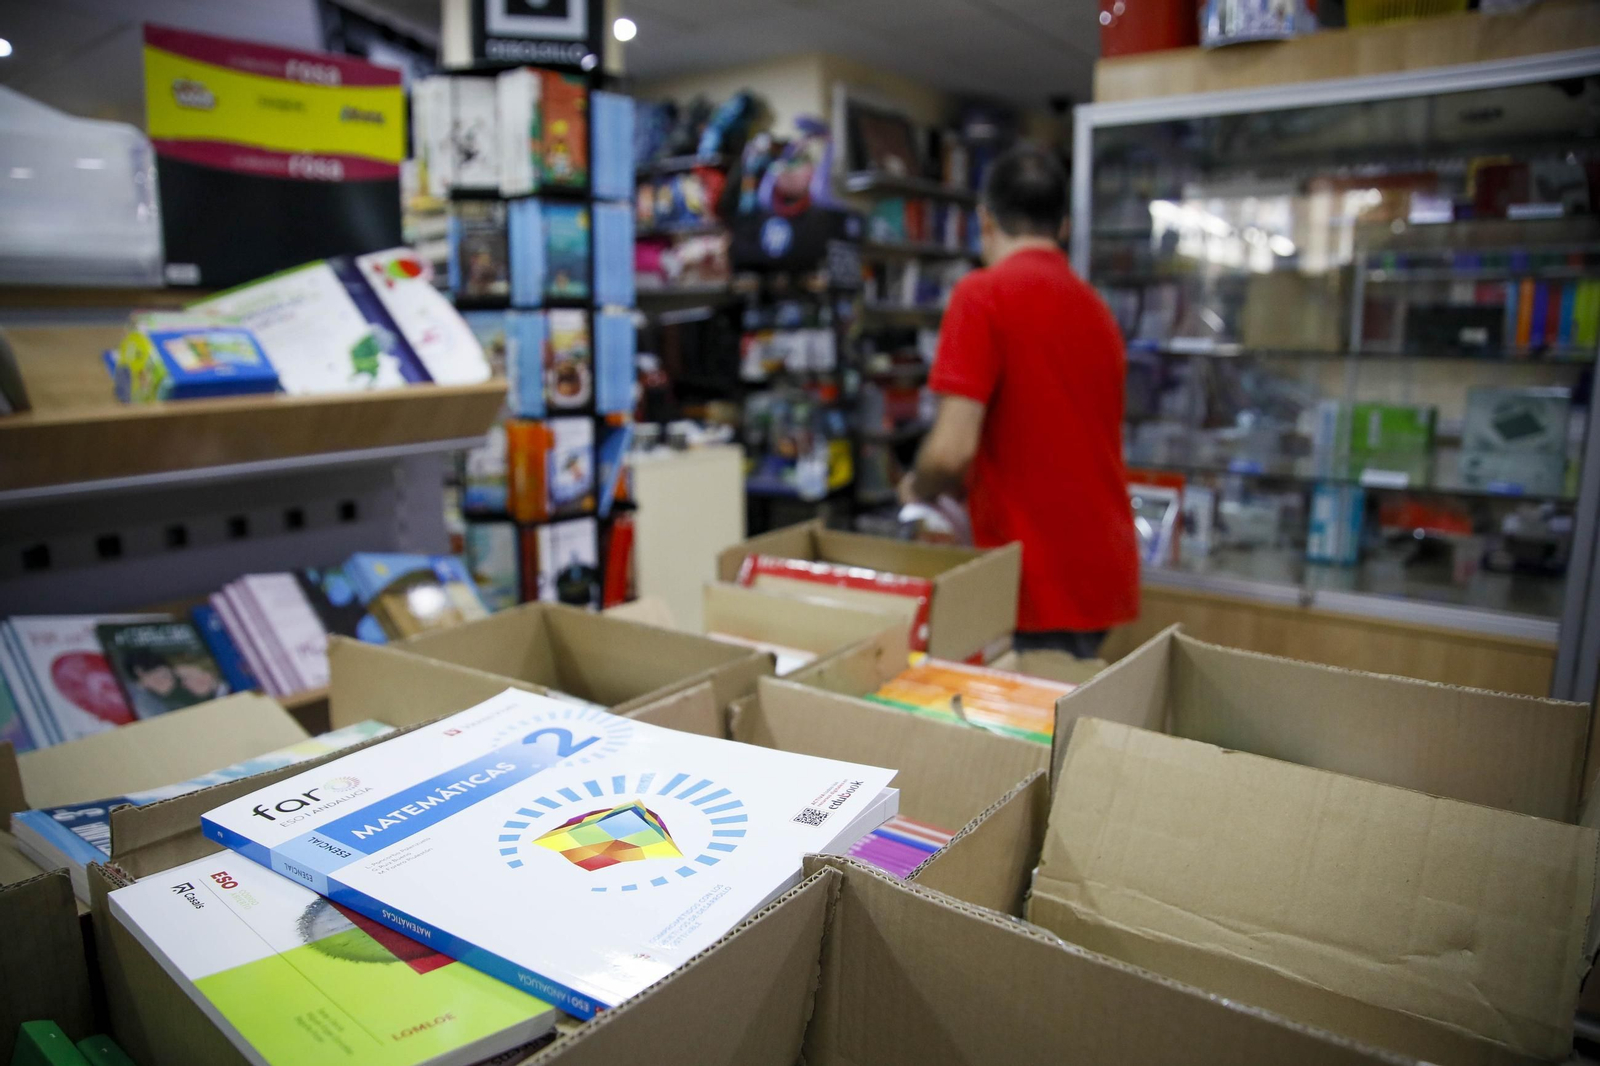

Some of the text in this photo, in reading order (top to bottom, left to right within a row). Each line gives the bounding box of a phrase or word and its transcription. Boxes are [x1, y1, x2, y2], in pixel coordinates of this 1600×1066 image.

[522, 727, 602, 758] 2
[279, 786, 374, 828] ESO ANDALUCÍA
[350, 762, 516, 840] MATEMÁTICAS
[828, 780, 864, 810] edubook
[307, 836, 352, 859] ESENCIAL
[210, 871, 239, 890] ESO
[283, 862, 314, 883] ESENCIAL
[184, 892, 205, 910] Casals
[381, 908, 431, 939] MATEMÁTICAS
[517, 971, 590, 1013] ESO ANDALUCÍA
[391, 1012, 456, 1042] LOMLOE
